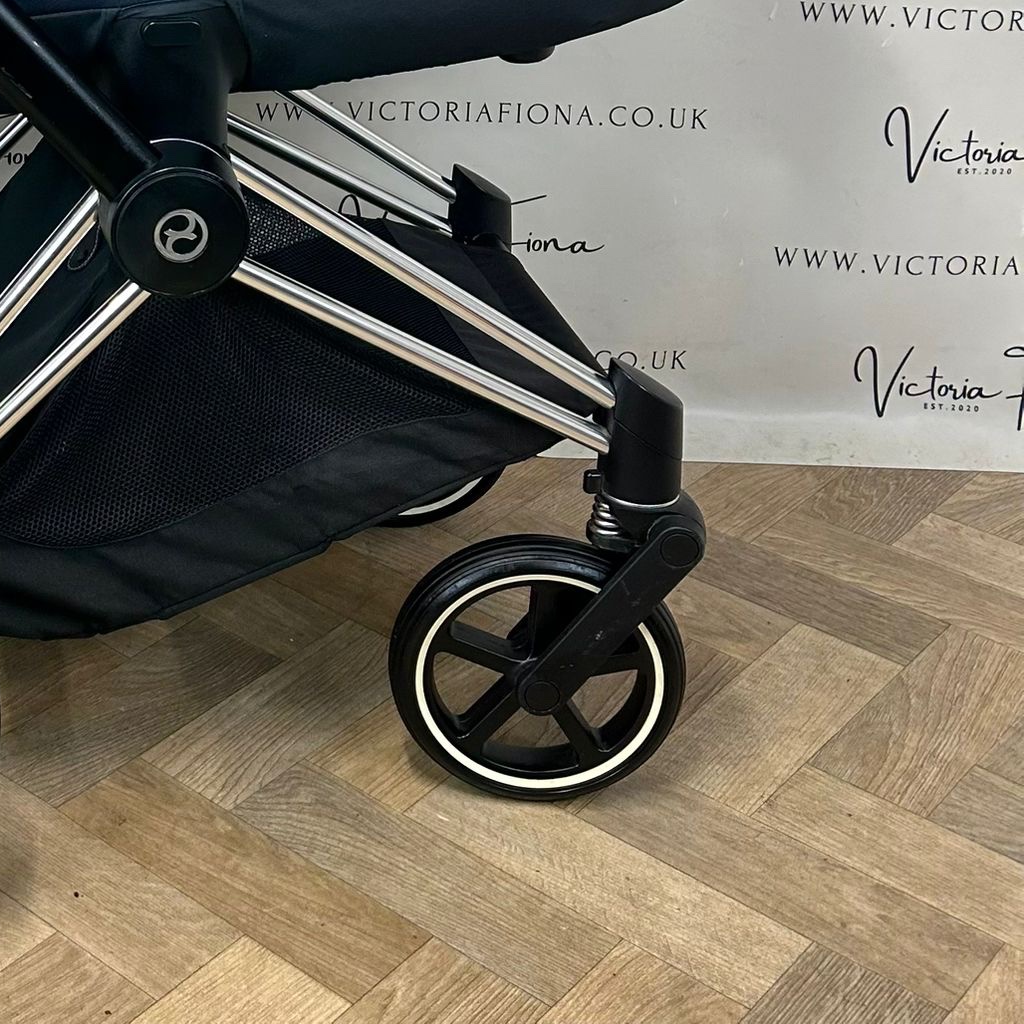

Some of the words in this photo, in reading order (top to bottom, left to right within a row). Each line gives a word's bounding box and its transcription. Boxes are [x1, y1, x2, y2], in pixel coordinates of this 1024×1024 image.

[884, 106, 1024, 184] Victoria
[956, 167, 1013, 176] EST.2020
[854, 346, 1003, 418] Victoria
[923, 403, 980, 412] EST.2020
